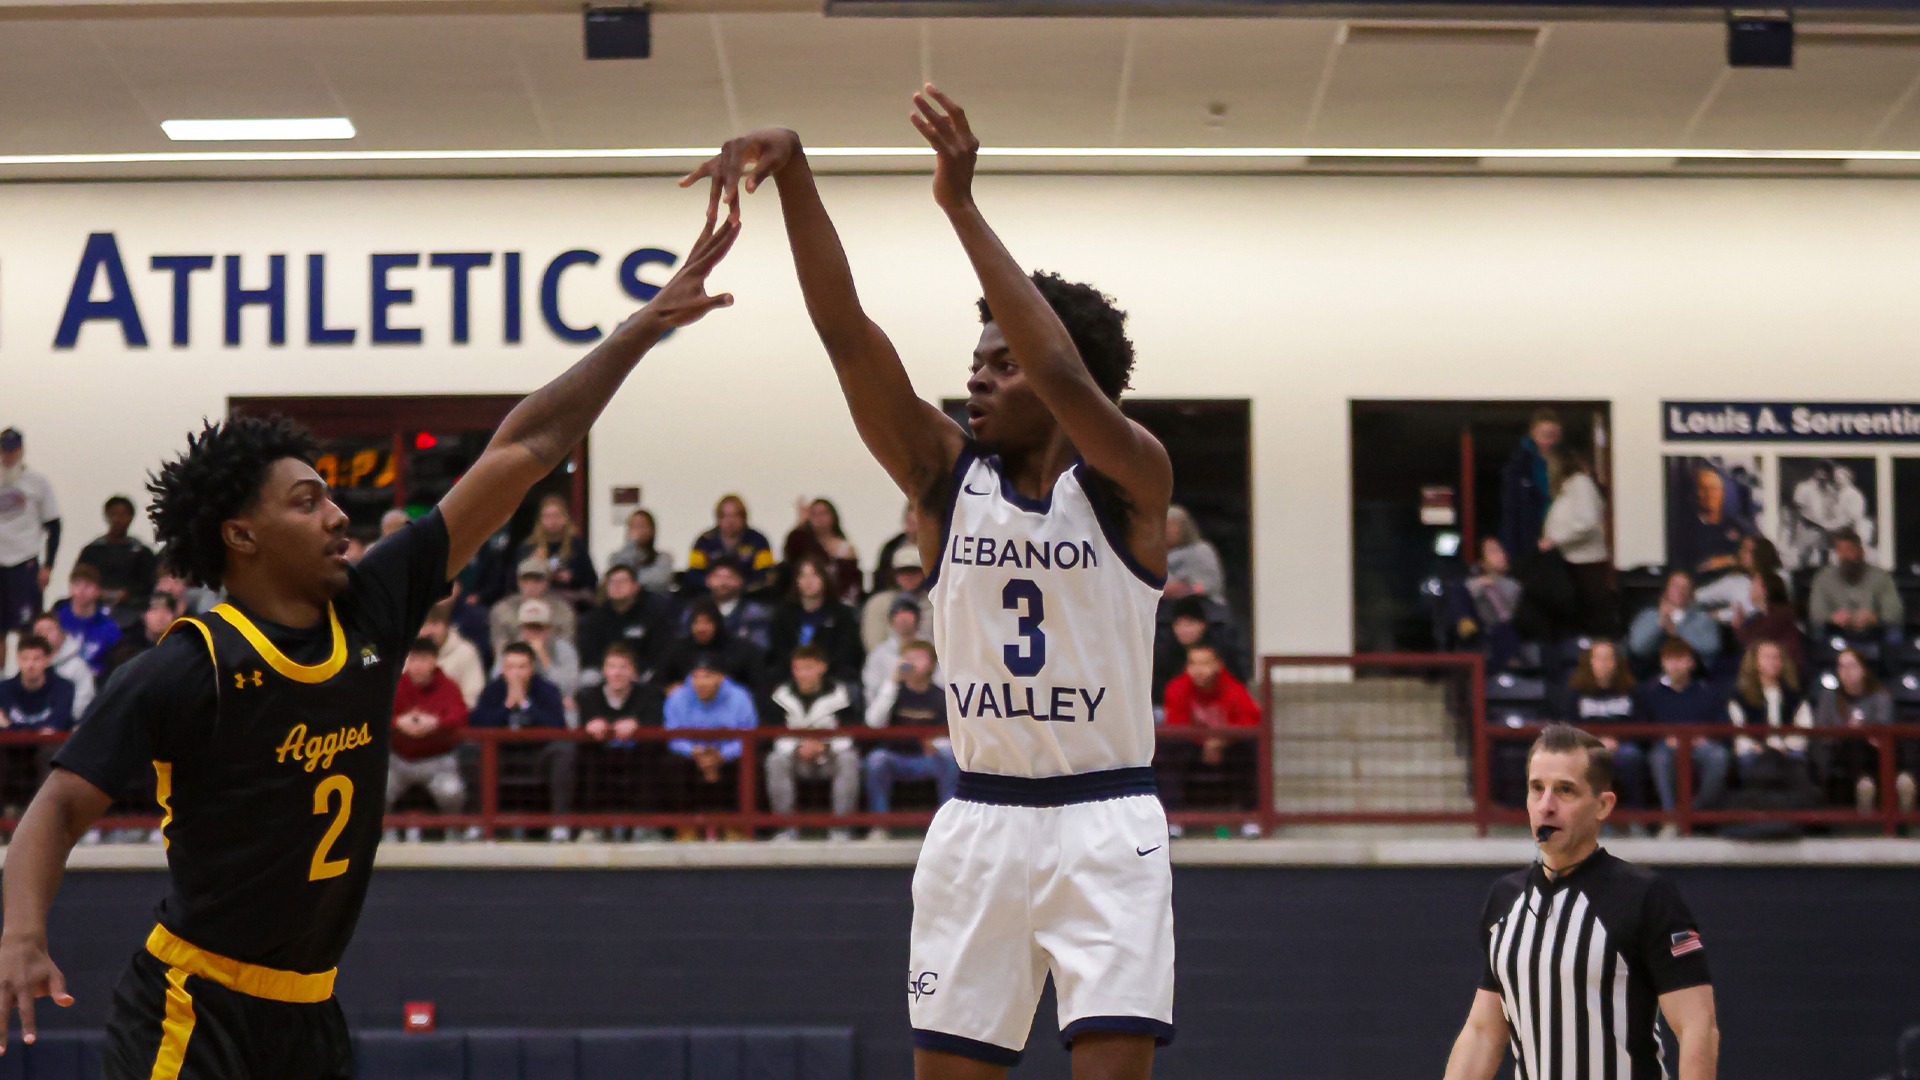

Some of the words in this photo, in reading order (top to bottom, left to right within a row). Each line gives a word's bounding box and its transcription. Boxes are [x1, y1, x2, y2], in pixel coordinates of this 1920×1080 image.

[53, 232, 678, 348] ATHLETICS
[1670, 406, 1751, 434] Louis
[1757, 407, 1787, 434] A.
[951, 534, 1098, 571] LEBANON
[1002, 578, 1046, 677] 3
[950, 682, 1106, 722] VALLEY
[276, 722, 373, 773] Aggies
[308, 774, 354, 882] 2
